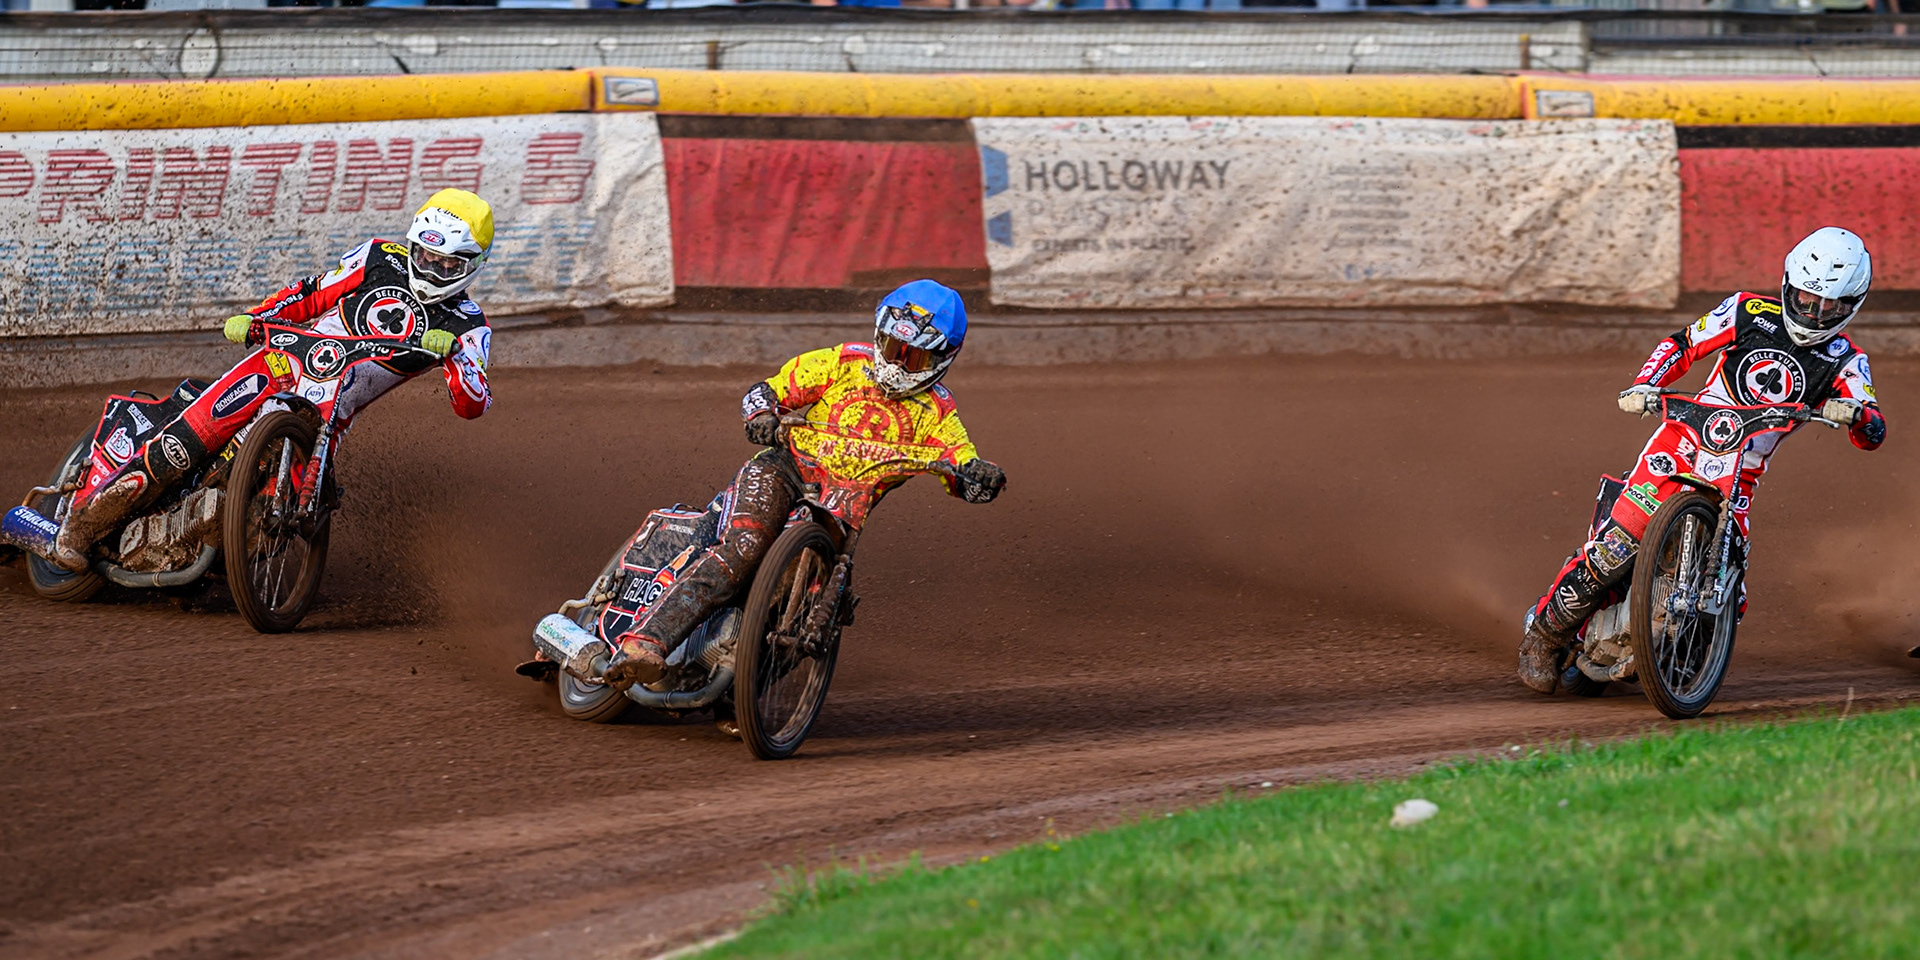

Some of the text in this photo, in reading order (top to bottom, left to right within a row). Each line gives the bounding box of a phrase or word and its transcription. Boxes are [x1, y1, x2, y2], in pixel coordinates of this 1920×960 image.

[1024, 159, 1231, 191] HOLLOWAY
[375, 290, 425, 337] BELLE VUE ACES
[273, 335, 297, 345] Arai
[1748, 352, 1775, 364] BELLE
[1778, 354, 1795, 369] VUE
[1792, 370, 1802, 392] ACES
[215, 382, 249, 412] BONIFACE
[128, 404, 148, 426] BONIFACE
[165, 437, 187, 466] Arai
[1628, 487, 1656, 512] ROCK OIL
[15, 508, 60, 535] STARLINGS
